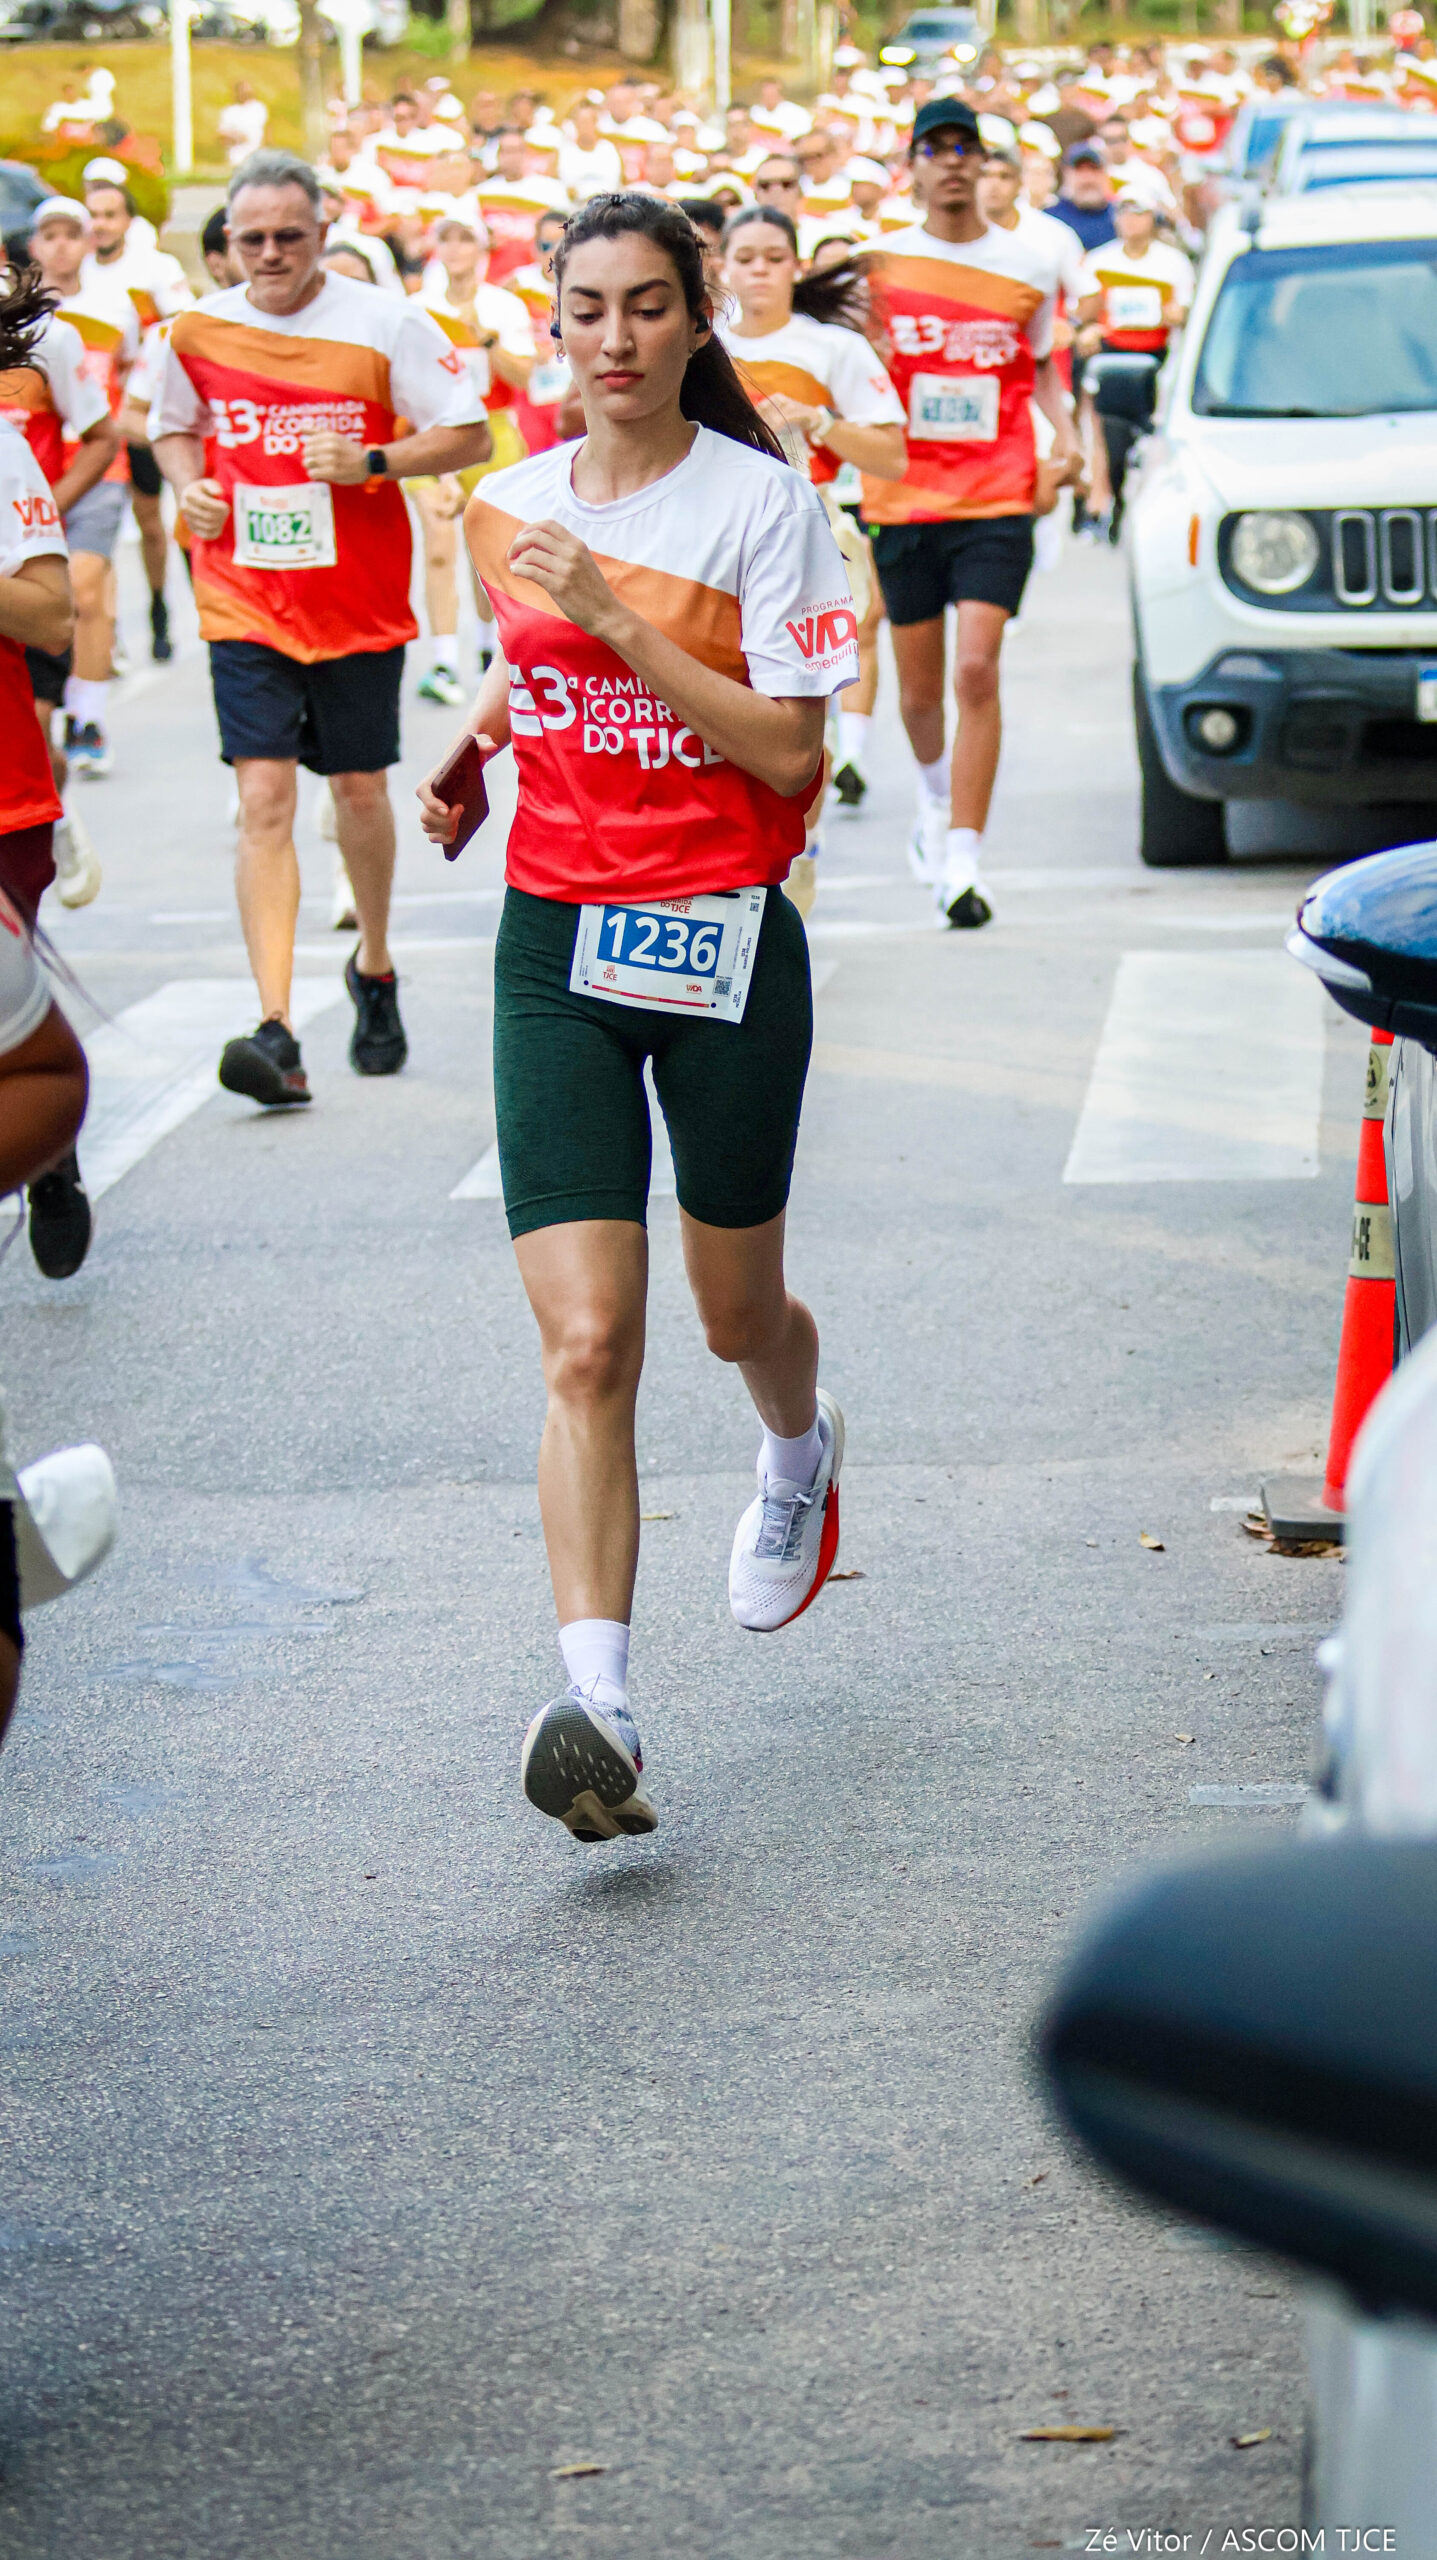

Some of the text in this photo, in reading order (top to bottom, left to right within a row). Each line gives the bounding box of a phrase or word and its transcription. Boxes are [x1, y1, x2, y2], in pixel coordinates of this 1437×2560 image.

[264, 434, 299, 456] DO
[249, 513, 311, 543] 1082
[801, 594, 853, 616] PROGRAMA
[585, 676, 650, 696] CAMI
[582, 696, 684, 724] /CORR
[583, 723, 624, 755] DO
[671, 903, 691, 914] TJCE
[606, 911, 719, 972] 1236
[603, 971, 618, 981] TJCE
